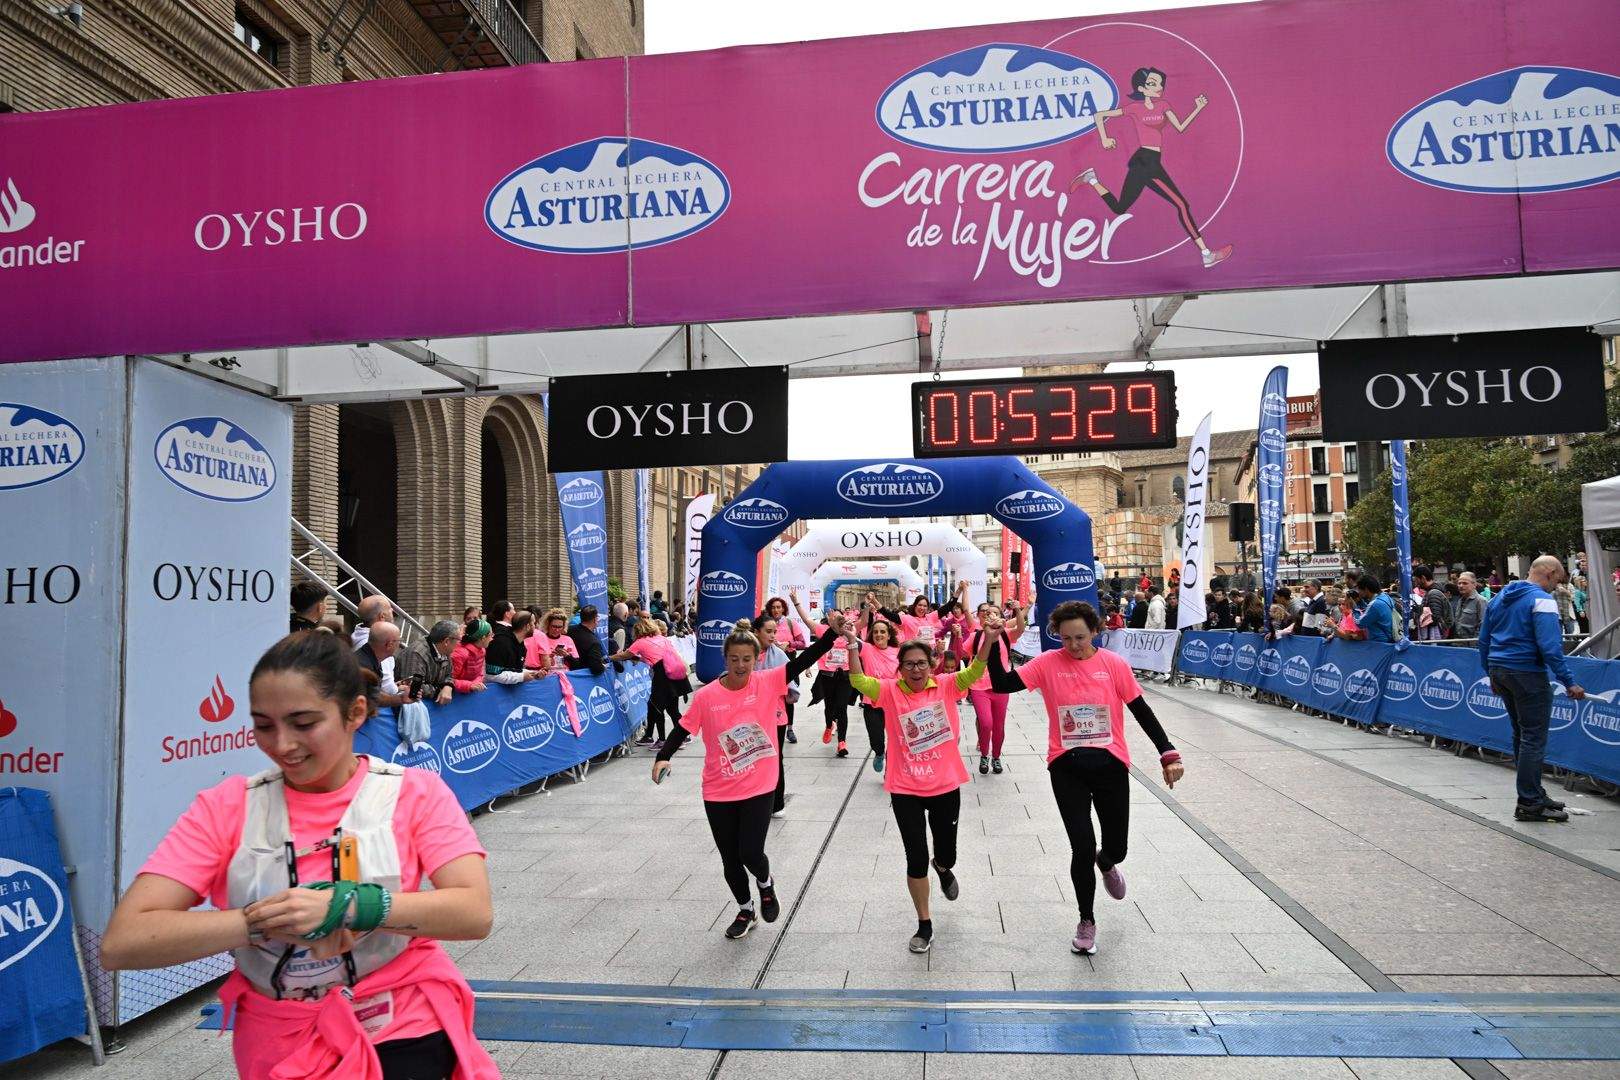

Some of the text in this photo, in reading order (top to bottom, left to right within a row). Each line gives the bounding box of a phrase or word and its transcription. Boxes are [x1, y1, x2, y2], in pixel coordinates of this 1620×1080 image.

[931, 76, 1092, 96] CENTRAL LECHERA
[895, 89, 1099, 130] ASTURIANA
[1453, 103, 1620, 127] CENTRAL LECHE
[541, 171, 703, 192] CENTRAL LECHERA
[857, 152, 1056, 208] Carrera
[503, 186, 712, 229] ASTURIANA
[194, 203, 368, 251] OYSHO
[906, 193, 1133, 288] de la Mujer
[0, 237, 85, 268] ander
[1365, 365, 1562, 410] OYSHO
[1286, 401, 1314, 414] IBUR
[586, 400, 754, 439] OYSHO
[15, 431, 68, 440] LECHERA
[0, 443, 73, 467] RIANA
[164, 437, 269, 488] ASTURIANA
[185, 440, 266, 463] CENTRAL LECHERA
[845, 477, 936, 496] ASTURIANA
[1286, 453, 1294, 497] HOTEL
[728, 509, 784, 521] ASTURIANA
[1001, 503, 1061, 515] ASTURIANA
[1183, 446, 1206, 590] OYSHO
[1288, 503, 1296, 545] TIBUR
[841, 530, 923, 549] OYSHO
[153, 563, 275, 603] OYSHO
[1046, 574, 1093, 586] ASTURIANA
[701, 632, 730, 641] STURI
[1125, 632, 1165, 652] OYSHO
[1387, 680, 1413, 694] TURIANA
[1422, 680, 1460, 702] ASTURIANA
[1468, 688, 1506, 709] ASTURIAN
[920, 721, 935, 732] 016
[1076, 721, 1094, 729] 016
[1584, 704, 1620, 732] ASTURI
[161, 726, 256, 763] Santande
[507, 721, 552, 745] ASTURIANA
[740, 736, 755, 747] 016
[448, 737, 497, 766] ASTURIANA
[903, 751, 942, 762] ORSA
